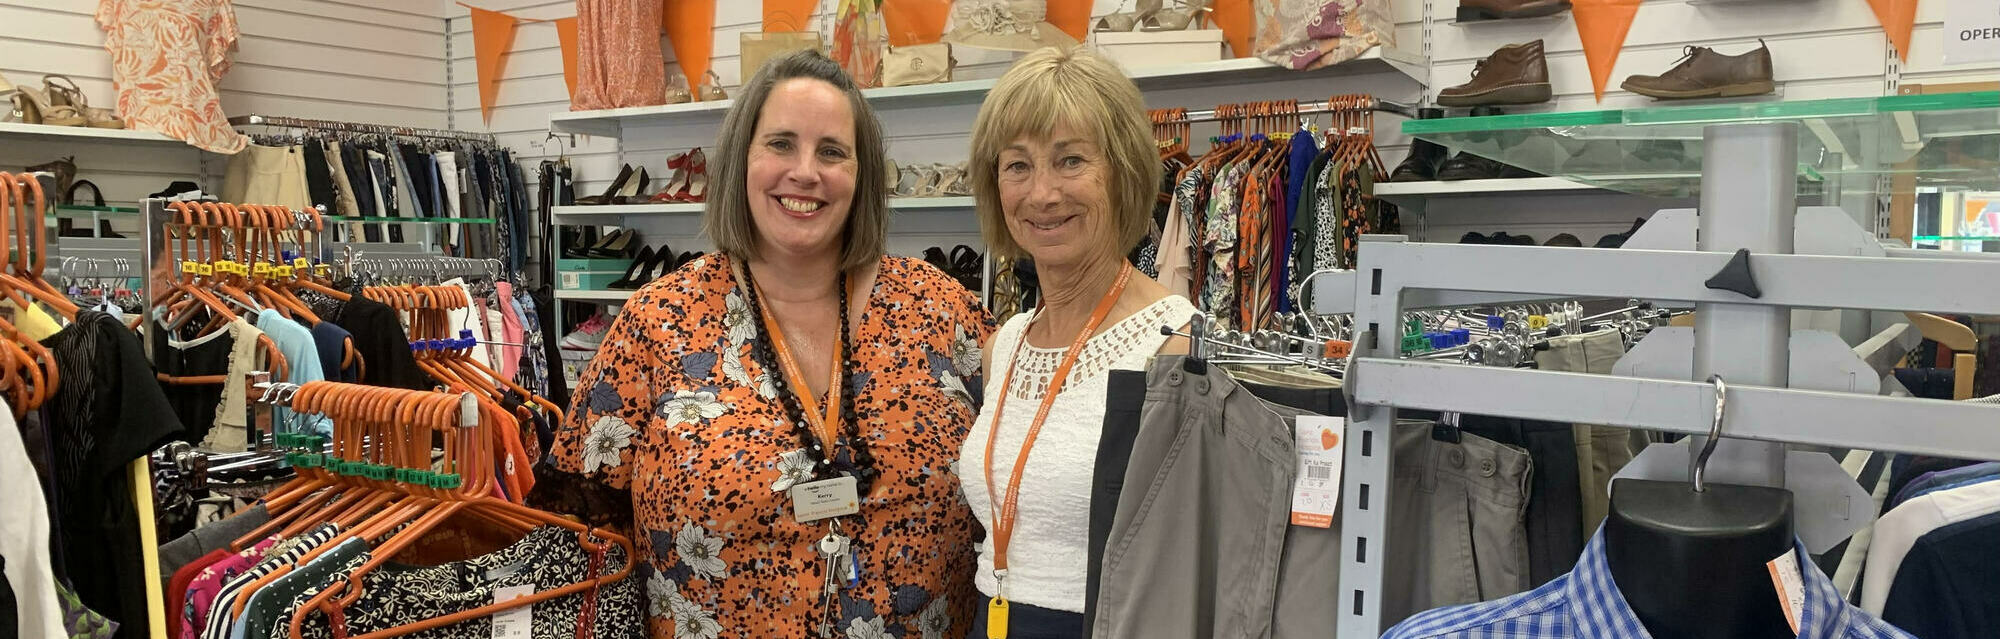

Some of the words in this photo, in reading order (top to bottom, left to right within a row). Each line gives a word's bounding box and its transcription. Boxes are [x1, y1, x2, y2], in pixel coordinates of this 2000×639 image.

[1960, 27, 2000, 41] OPER
[1306, 345, 1314, 354] S
[1332, 345, 1343, 354] 34
